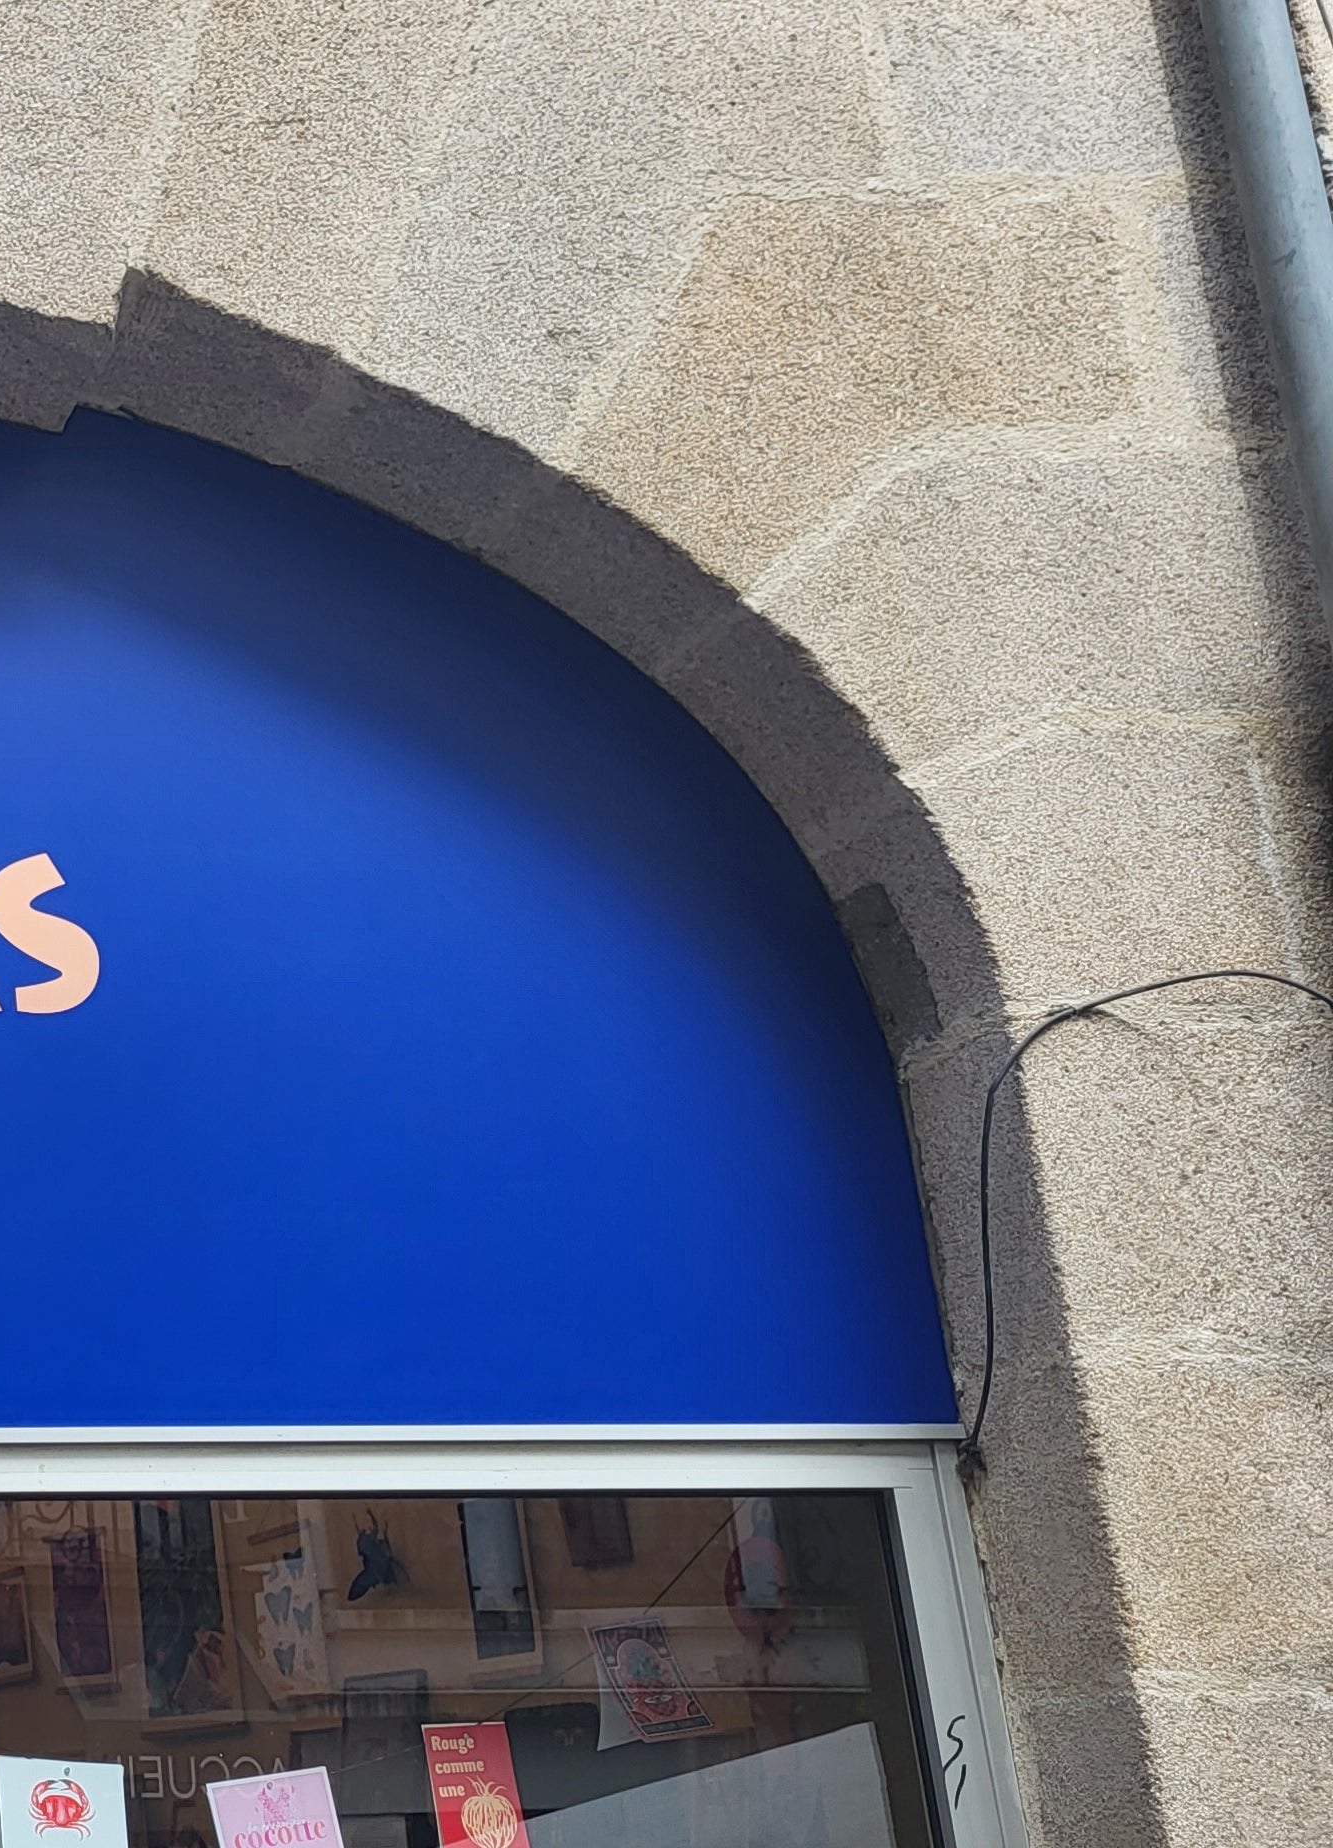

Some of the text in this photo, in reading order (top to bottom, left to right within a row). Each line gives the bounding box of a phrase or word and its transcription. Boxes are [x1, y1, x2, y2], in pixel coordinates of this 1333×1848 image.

[430, 1735, 475, 1754] Rouge
[435, 1760, 485, 1775] comme
[438, 1784, 466, 1798] une
